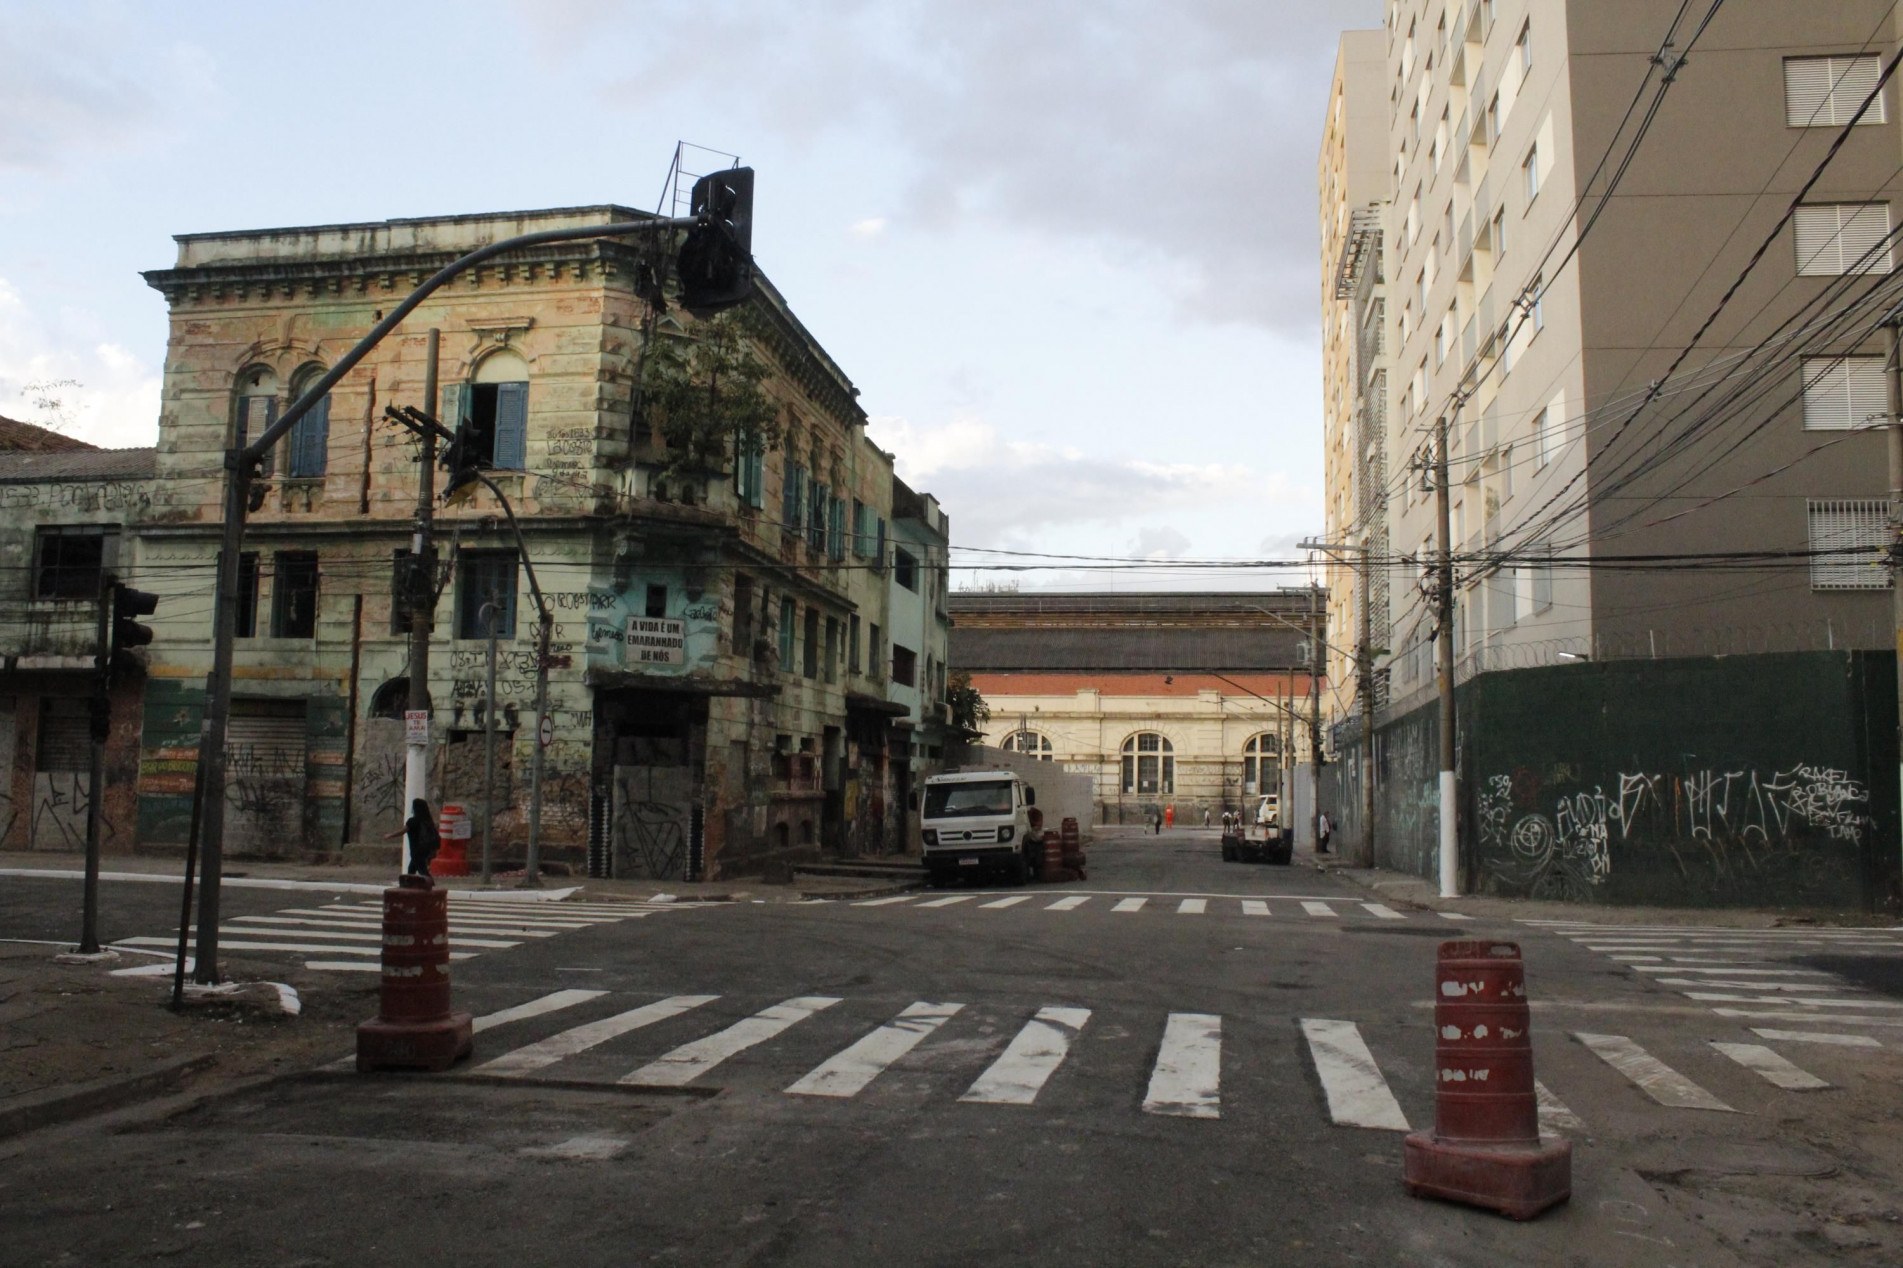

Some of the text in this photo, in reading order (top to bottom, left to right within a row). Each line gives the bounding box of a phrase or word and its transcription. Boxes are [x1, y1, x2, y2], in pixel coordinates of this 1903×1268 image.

[631, 620, 680, 634] A VIDA É UM
[627, 634, 683, 649] EMARANHADO
[641, 649, 670, 662] DE NÓS
[405, 712, 427, 720] JESUS
